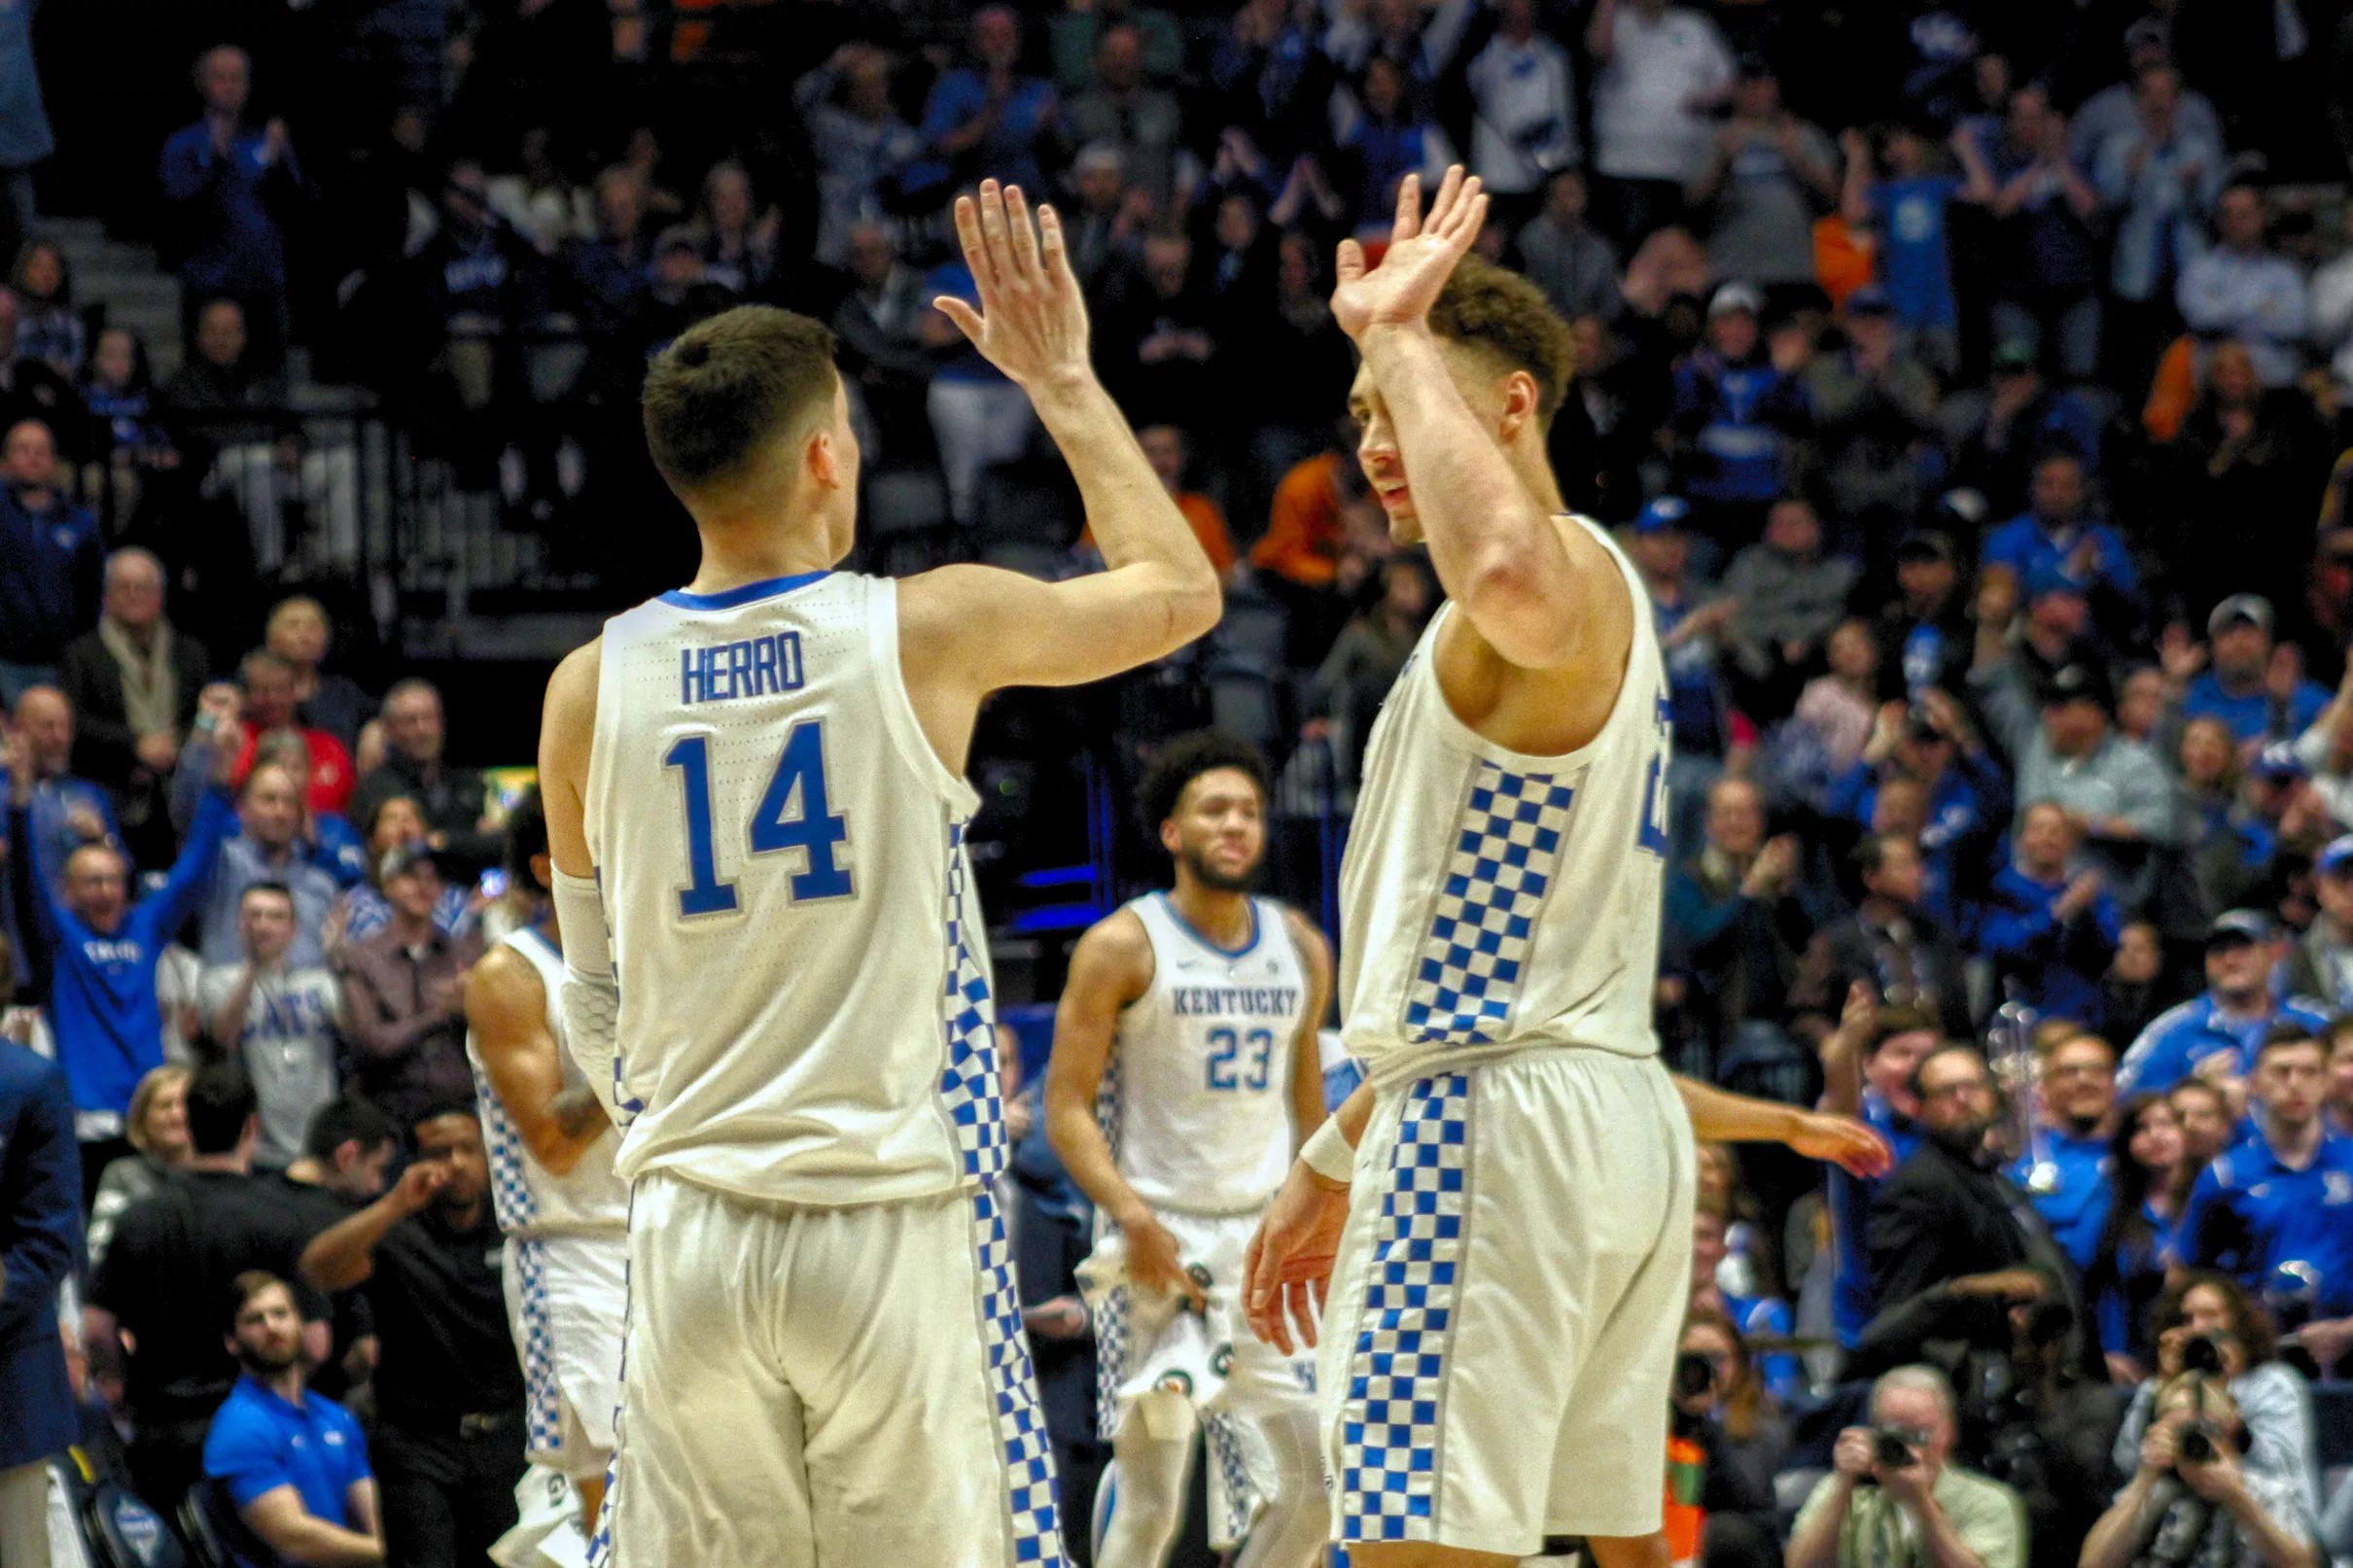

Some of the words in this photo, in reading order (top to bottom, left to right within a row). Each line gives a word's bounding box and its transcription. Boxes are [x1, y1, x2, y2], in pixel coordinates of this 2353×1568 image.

[682, 630, 804, 705] HERRO
[662, 717, 856, 918] 14
[1174, 987, 1296, 1016] KENTUCKY
[1207, 1027, 1274, 1091] 23
